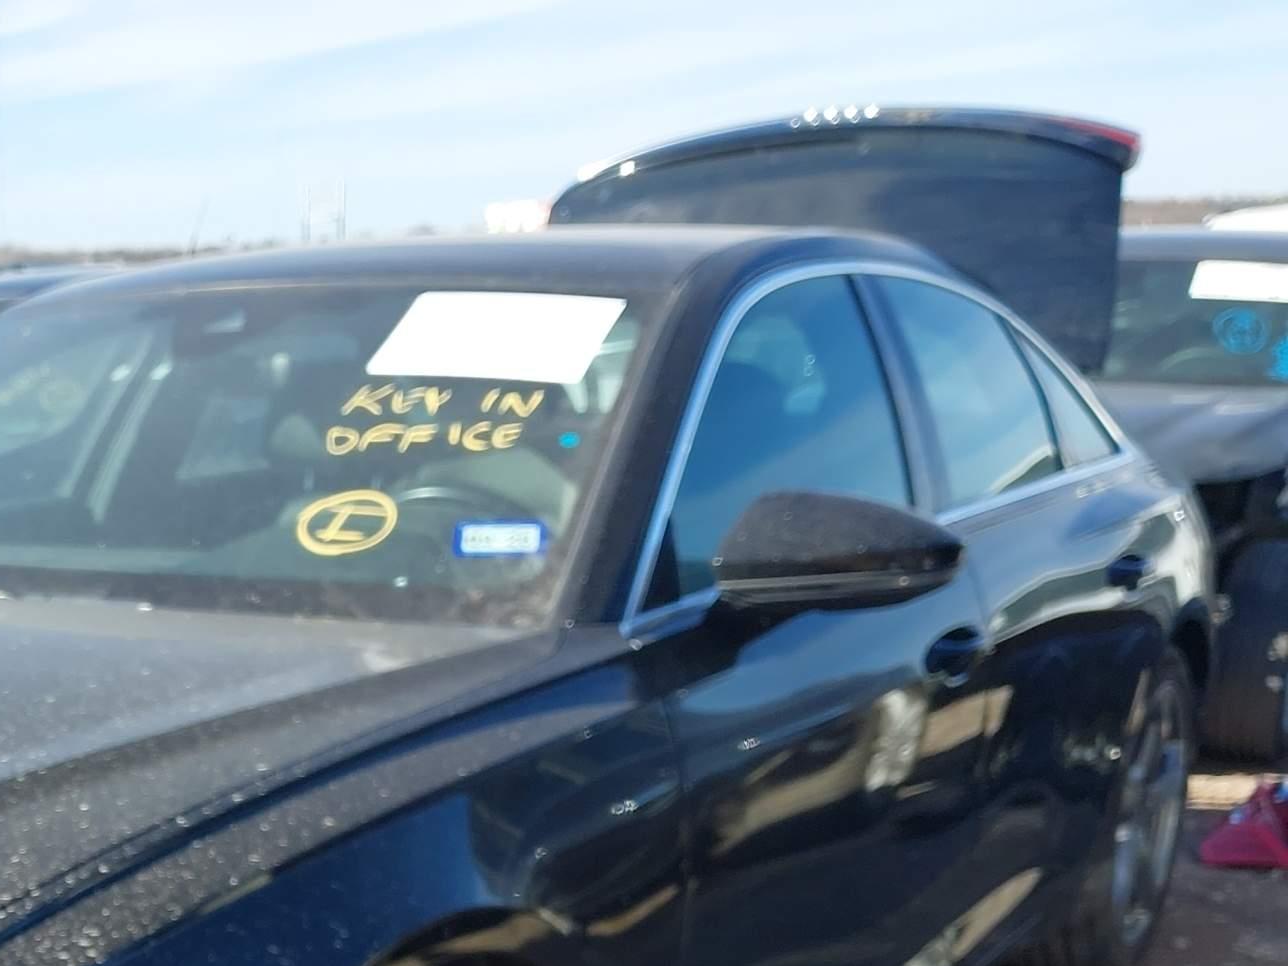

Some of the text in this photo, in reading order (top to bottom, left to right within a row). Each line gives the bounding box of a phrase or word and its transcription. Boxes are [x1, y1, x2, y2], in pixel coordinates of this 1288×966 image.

[341, 382, 545, 418] KEY IN
[325, 420, 523, 456] OFFICE
